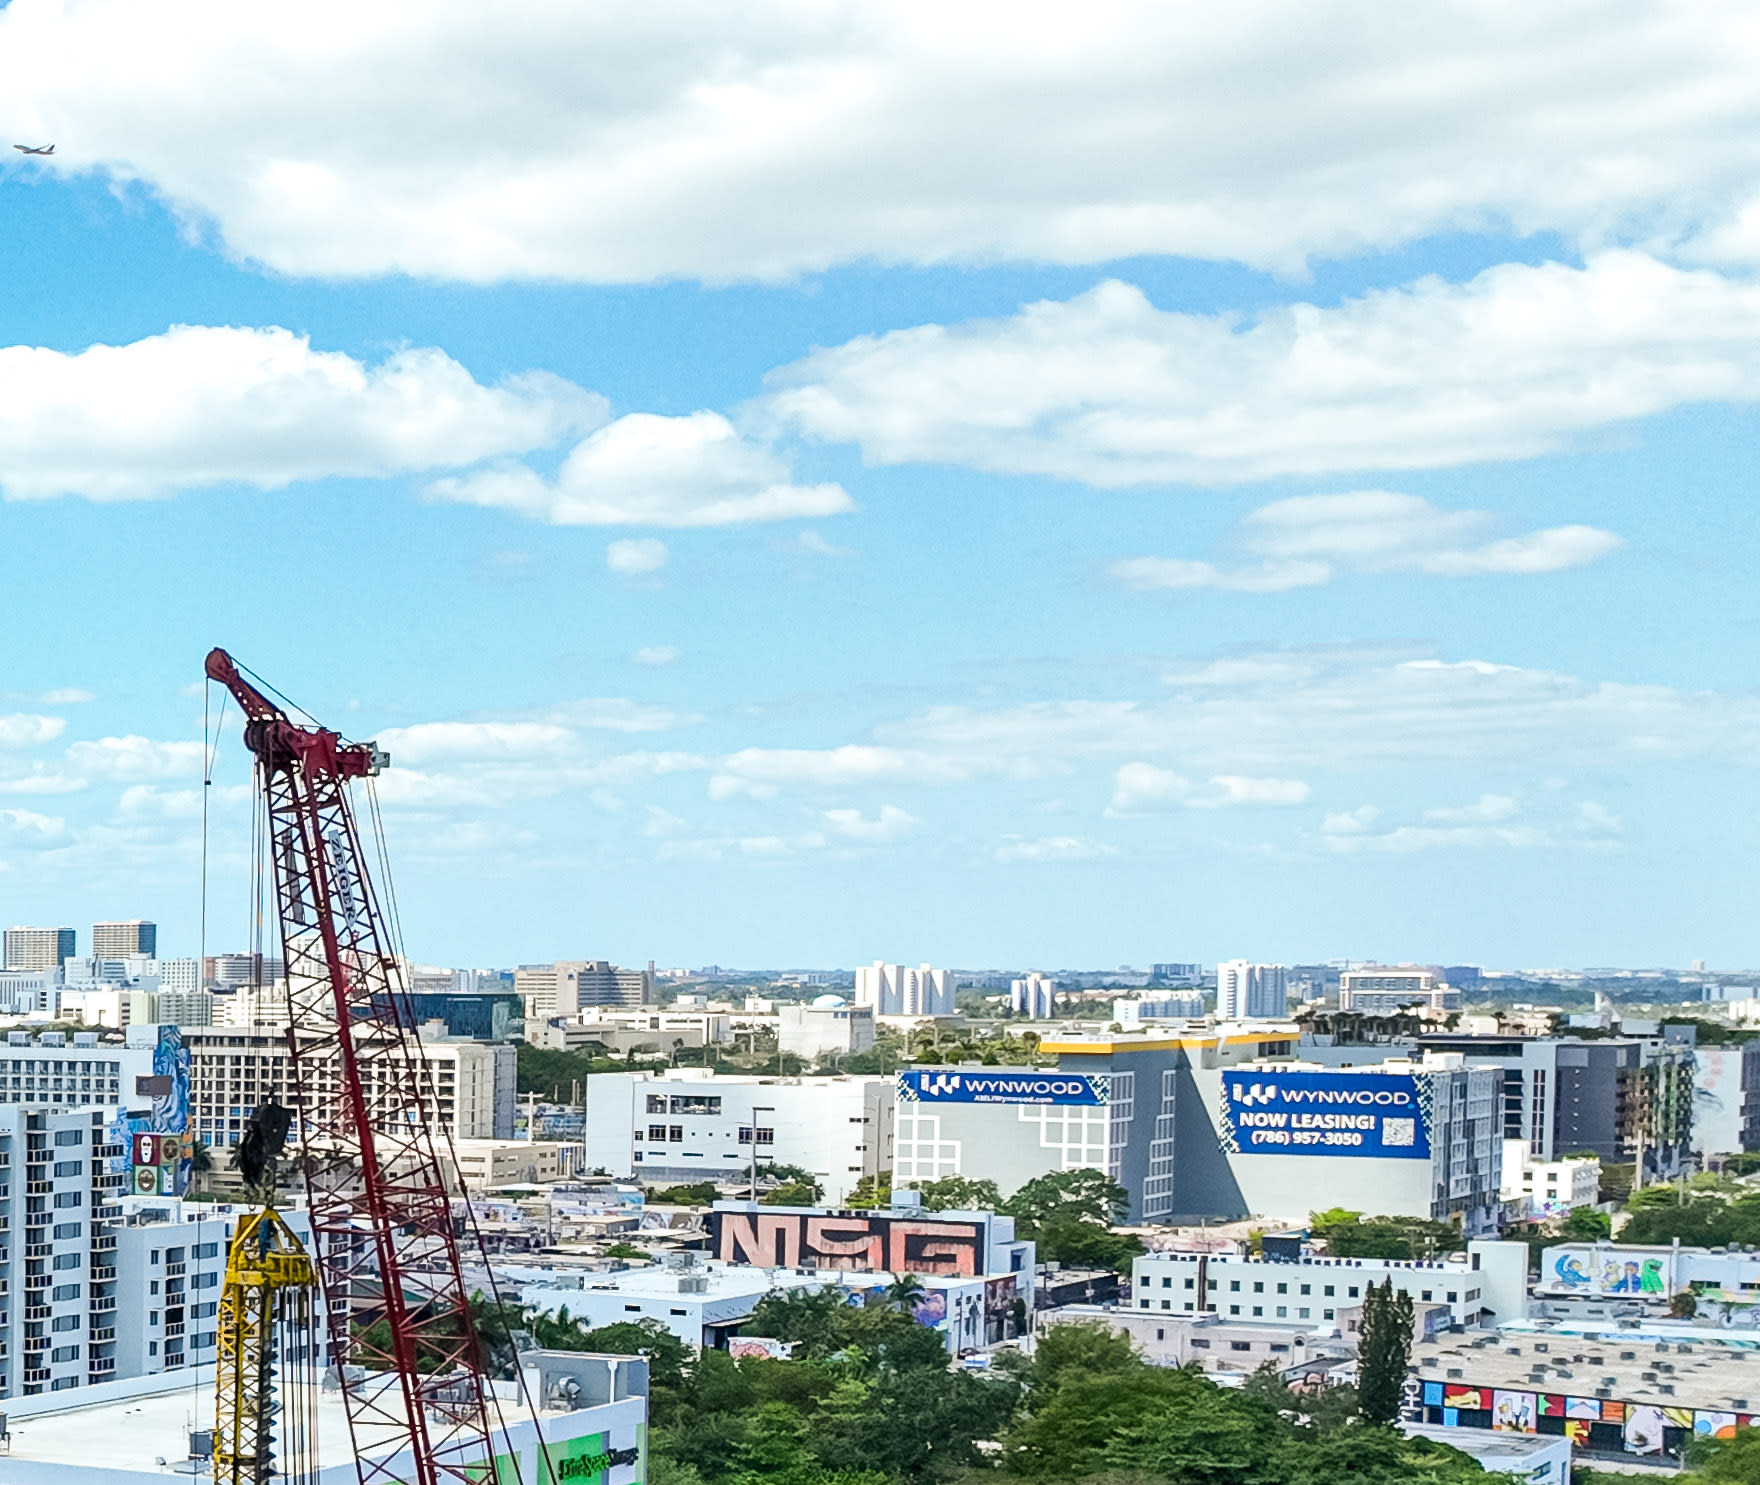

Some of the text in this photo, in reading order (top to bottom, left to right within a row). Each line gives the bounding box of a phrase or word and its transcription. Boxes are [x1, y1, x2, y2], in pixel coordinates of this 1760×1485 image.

[332, 838, 356, 920] ZEIGER
[965, 1079, 1083, 1095] WYNWOOD
[1281, 1089, 1410, 1105] WYNWOOD
[1239, 1112, 1376, 1130] NOW LEASING!
[1251, 1130, 1362, 1146] (786) 957-3050
